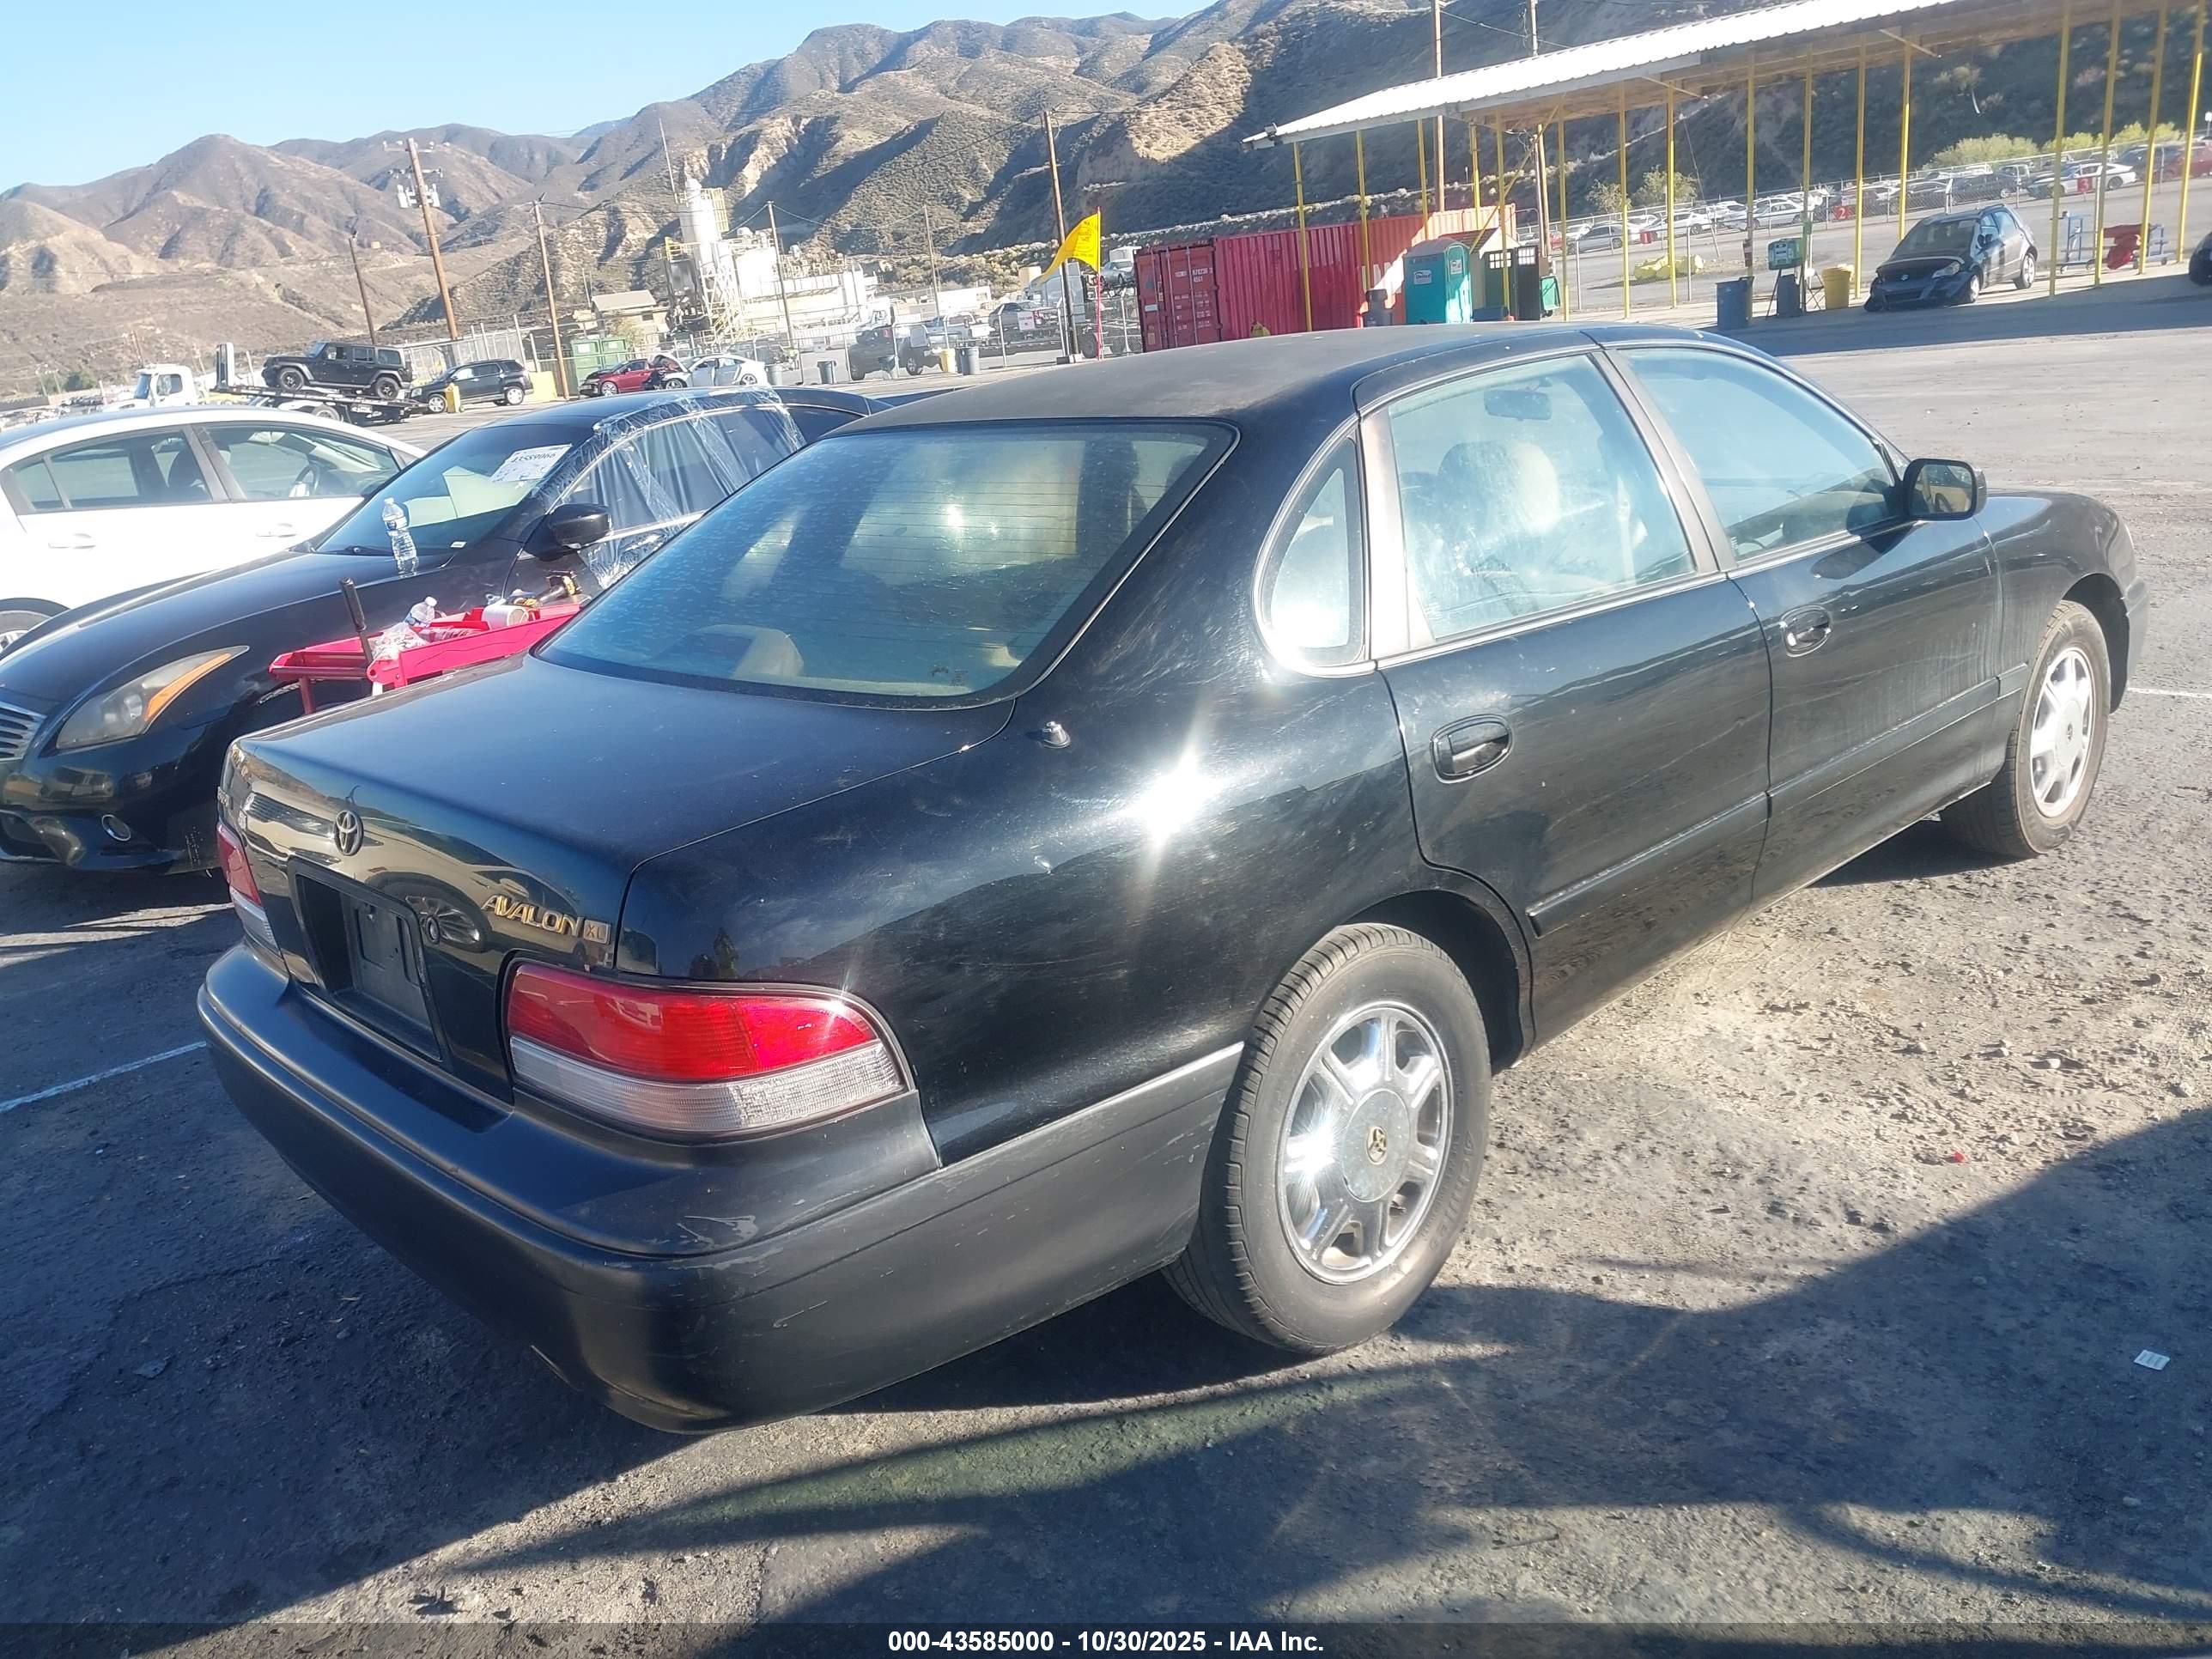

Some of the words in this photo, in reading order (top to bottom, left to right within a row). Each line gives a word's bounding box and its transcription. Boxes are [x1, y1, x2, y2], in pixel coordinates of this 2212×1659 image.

[2081, 178, 2089, 191] 3
[1838, 207, 1846, 220] 2
[480, 894, 585, 938] AVALON
